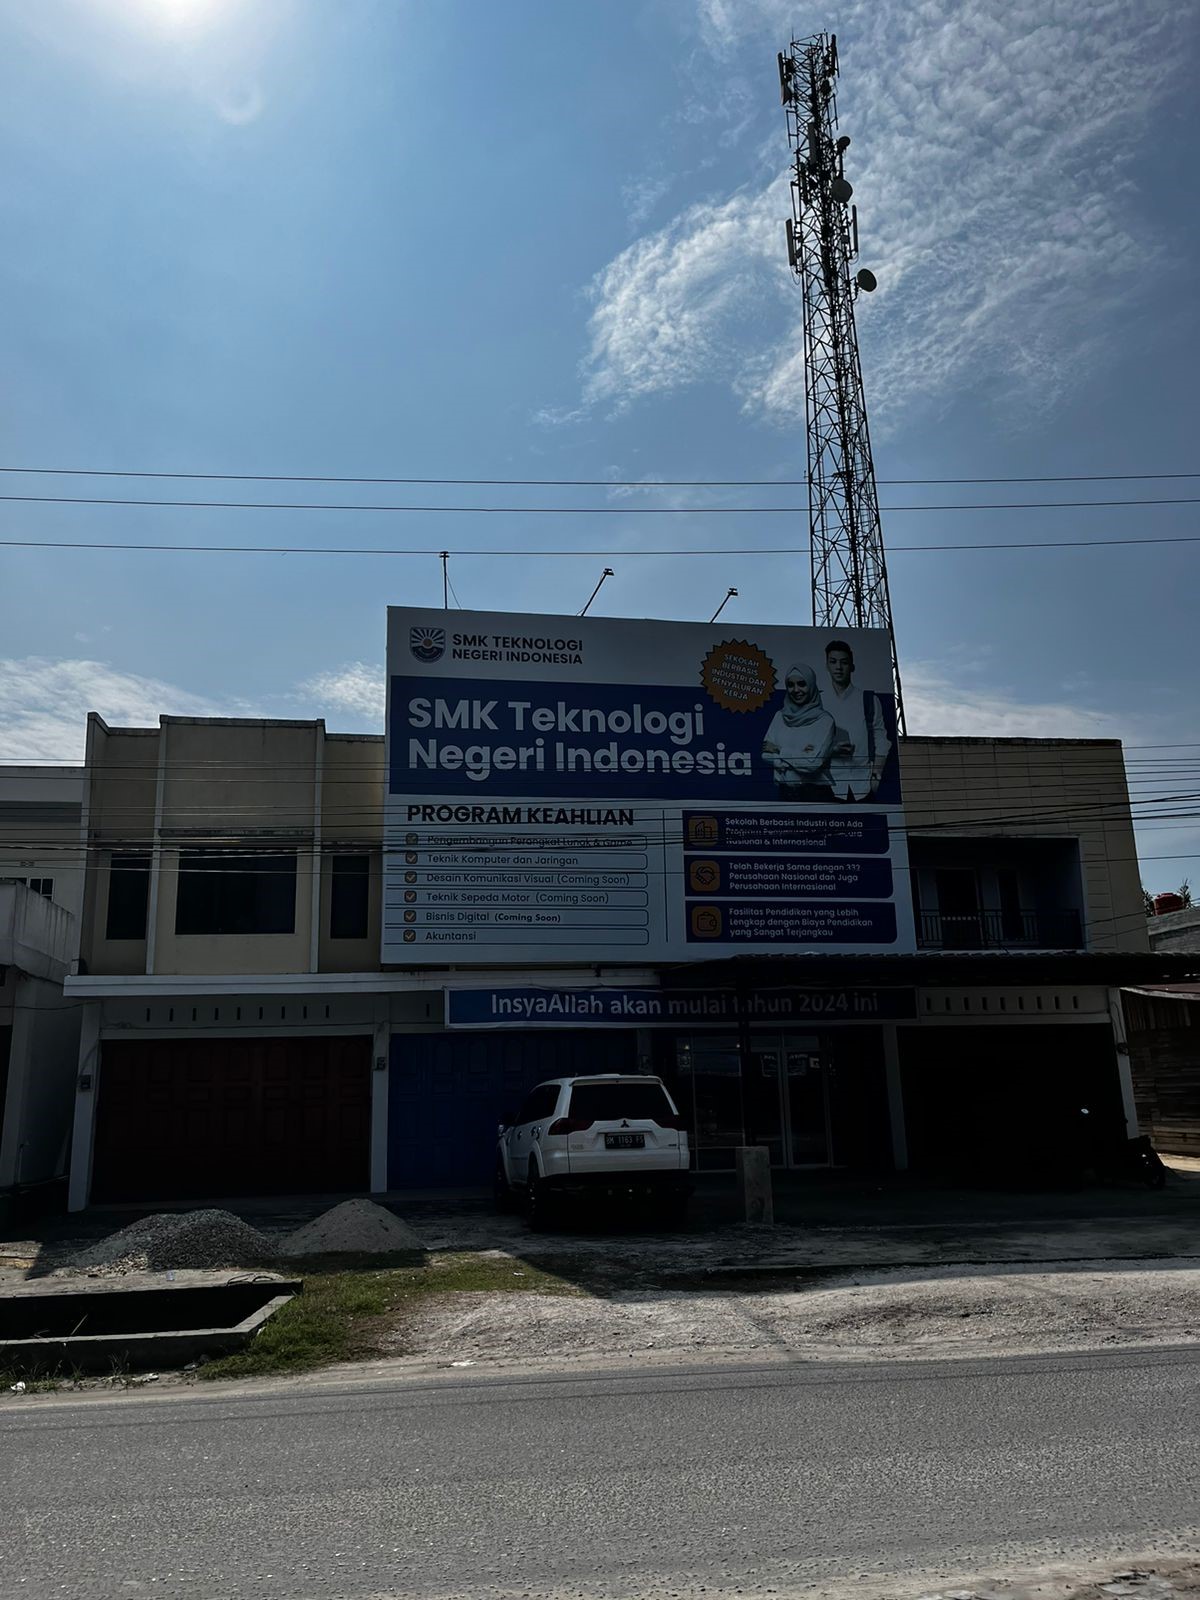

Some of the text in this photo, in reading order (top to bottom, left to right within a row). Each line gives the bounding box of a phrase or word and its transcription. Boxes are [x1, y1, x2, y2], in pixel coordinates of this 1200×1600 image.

[453, 635, 583, 651] SMK TEKNOLOGI
[452, 649, 583, 665] NEGERI INDONESIA
[724, 654, 759, 667] SEKOLAH
[712, 677, 763, 694] PENYALURAN
[748, 678, 766, 687] DAN
[723, 689, 748, 700] KERJA
[408, 697, 705, 744] SMK Teknologi
[409, 738, 752, 781] Negeri Indonesia
[408, 805, 634, 825] PROGRAM KEAHLIAN
[725, 818, 757, 826] Sekolah
[759, 818, 794, 827] Berbasis
[796, 819, 827, 827] Industri
[829, 820, 844, 828] dan
[427, 855, 578, 866] Teknik Komputer dan Jaringan
[753, 863, 784, 872] Bekerja
[786, 863, 810, 871] Sama
[812, 864, 844, 873] dengan
[427, 874, 630, 886] Desain Komunikasi Visual (Coming Soon)
[729, 872, 779, 881] Perusahaan
[781, 873, 817, 881] Nasional
[837, 874, 858, 883] Juga
[729, 882, 836, 891] Perusahaan Internasional
[427, 893, 609, 904] Teknik Sepeda Motor (Coming Soon)
[426, 912, 560, 923] Bisnis Digital (Coming Soon)
[729, 908, 763, 916] Fasilitas
[765, 908, 811, 916] Pendidikan
[813, 910, 835, 918] yang
[730, 918, 766, 928] Lengkap
[767, 918, 799, 928] dengan
[801, 919, 825, 928] Biaya
[425, 932, 476, 940] Akuntansi
[729, 928, 833, 938] yang Sangat Terjangkau
[491, 994, 603, 1017] InsyaAllah
[610, 996, 662, 1015] akan
[667, 995, 727, 1015] mulai
[799, 993, 848, 1013] 2024
[852, 992, 879, 1012] ini
